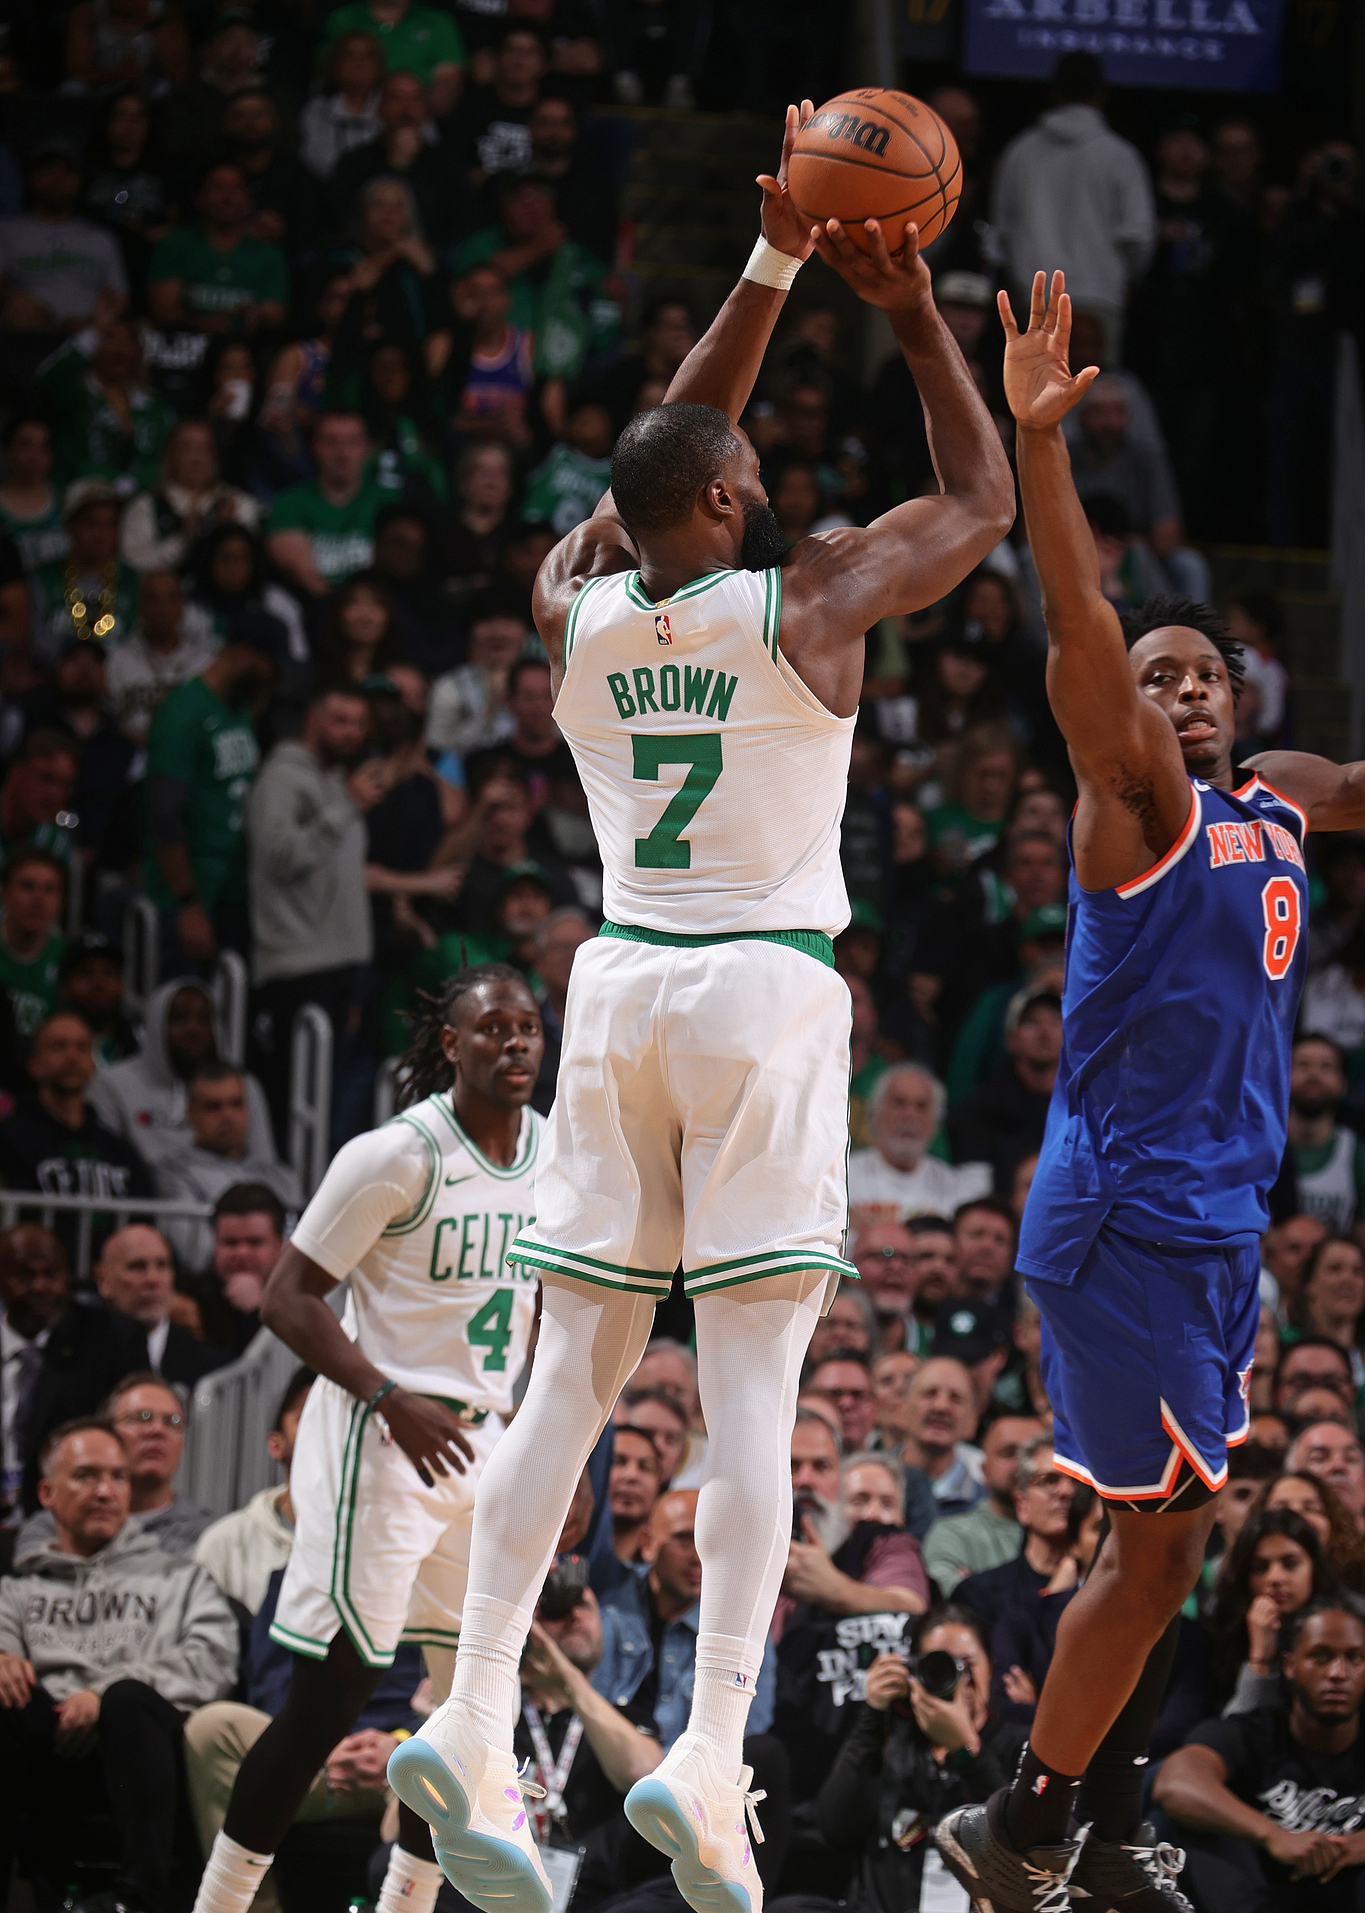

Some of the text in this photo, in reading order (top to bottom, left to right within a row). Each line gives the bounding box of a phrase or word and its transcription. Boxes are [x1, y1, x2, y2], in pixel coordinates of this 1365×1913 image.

[606, 664, 739, 722] BROWN
[631, 733, 723, 869] 7
[1205, 817, 1266, 869] NEW
[1261, 876, 1301, 981] 8
[467, 1288, 514, 1371] 4
[26, 1592, 157, 1626] BROWN
[835, 1611, 910, 1649] STAY
